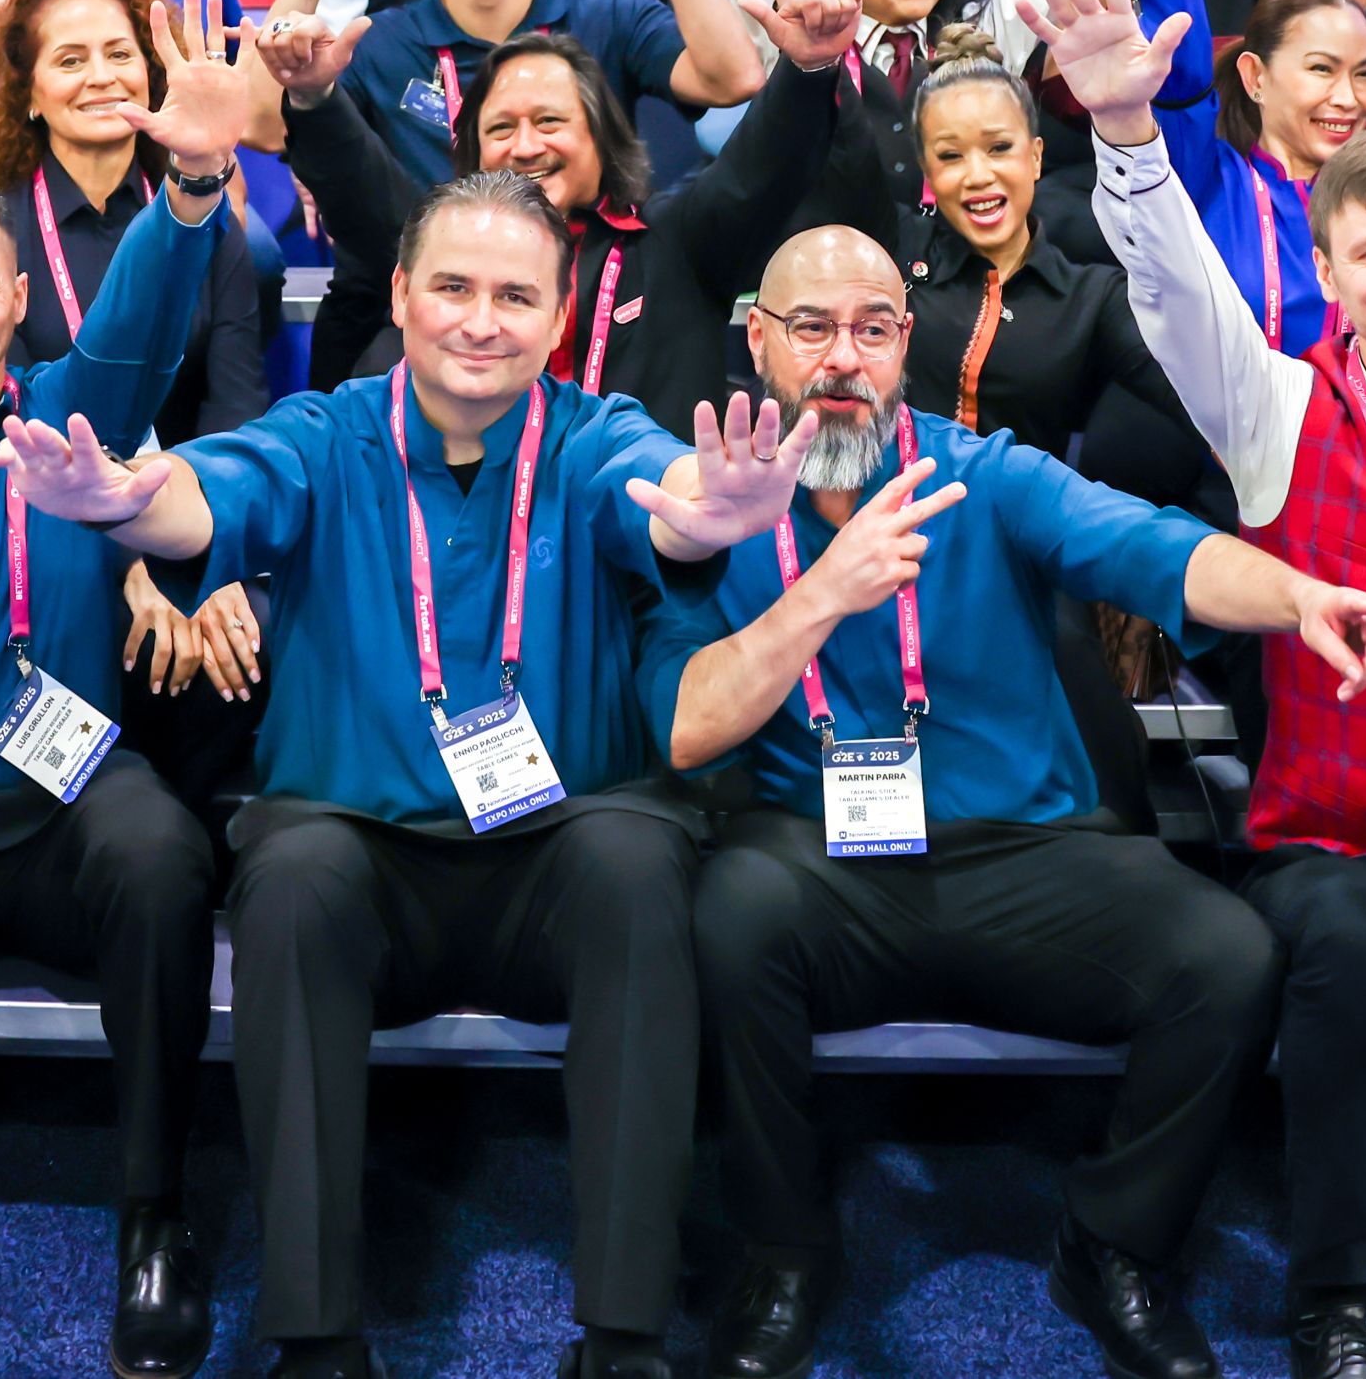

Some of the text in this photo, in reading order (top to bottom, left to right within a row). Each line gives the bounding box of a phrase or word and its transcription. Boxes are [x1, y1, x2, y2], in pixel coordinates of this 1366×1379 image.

[588, 336, 603, 384] Ortak.me
[517, 461, 531, 518] Ortak.me
[13, 534, 23, 600] BETCONSTRUCT
[510, 556, 523, 624] BETCONSTRUCT
[419, 595, 432, 653] Ortak.me
[902, 599, 915, 667] BETCONSTRUCT
[14, 686, 36, 712] 2025
[16, 697, 54, 748] LUIS GRULLON
[34, 709, 71, 761] TABLE GAME DEALER
[442, 708, 506, 742] G2E 2025
[453, 743, 478, 758] ENNIO
[480, 725, 523, 747] PAOLICCHI
[72, 772, 87, 791] EXPO
[85, 755, 99, 772] HALL
[97, 736, 112, 754] ONLY
[831, 751, 899, 762] G2E 2025
[838, 772, 906, 781] MARTIN PARRA
[485, 791, 550, 824] EXPO HALL ONLY
[842, 842, 911, 853] EXPO HALL ONLY
